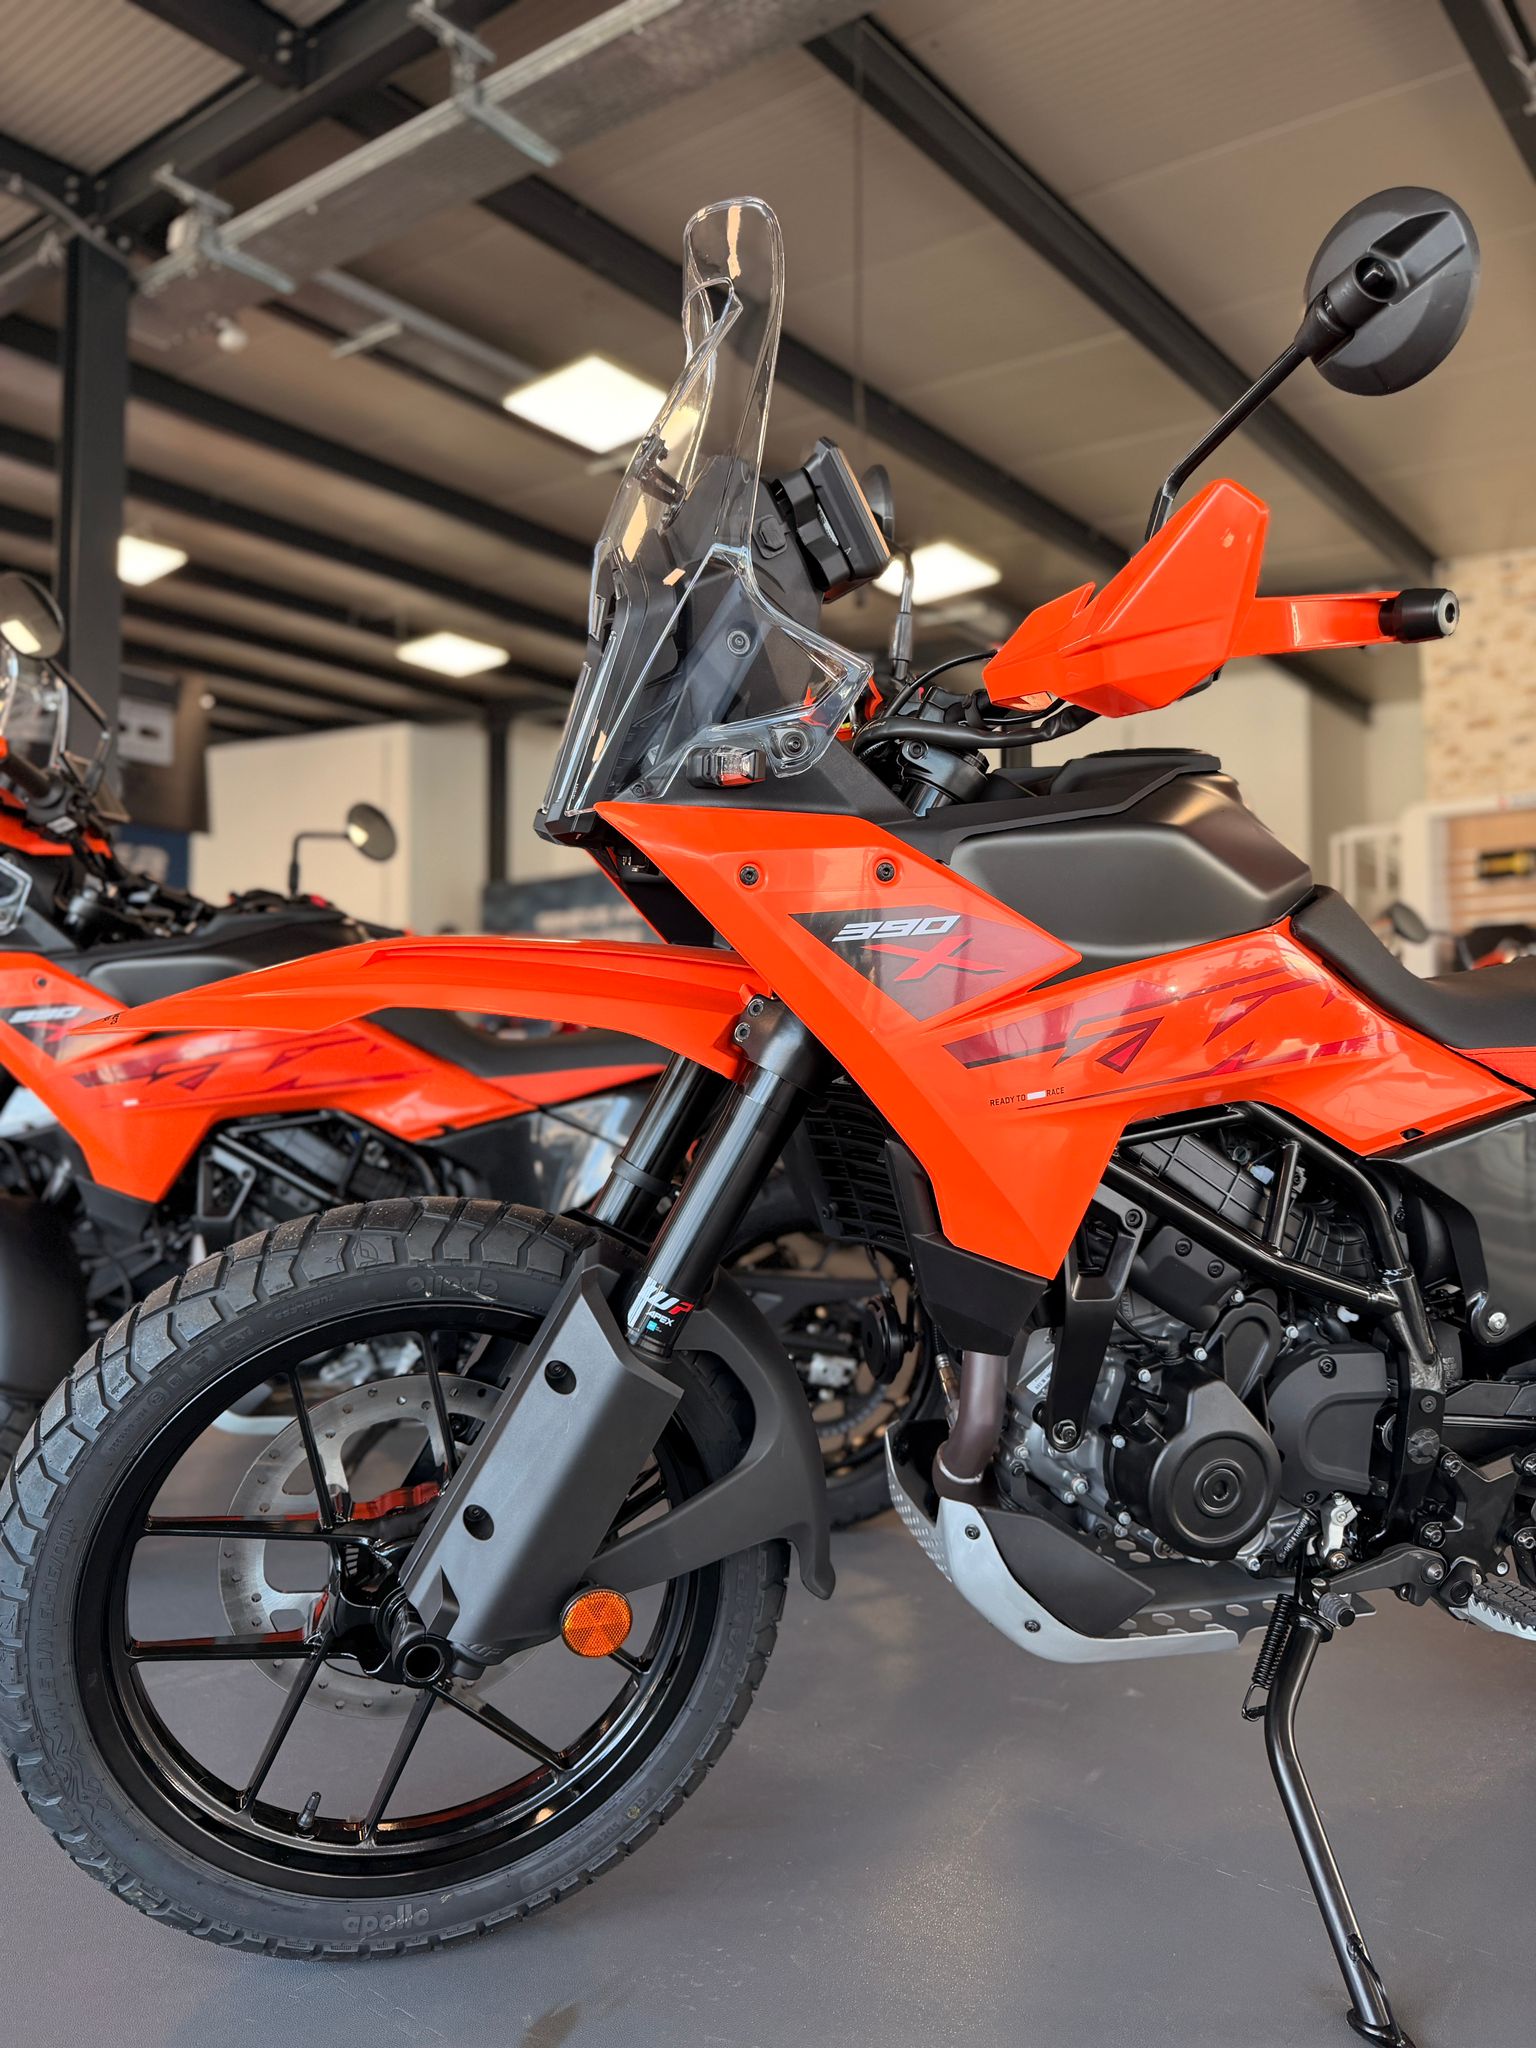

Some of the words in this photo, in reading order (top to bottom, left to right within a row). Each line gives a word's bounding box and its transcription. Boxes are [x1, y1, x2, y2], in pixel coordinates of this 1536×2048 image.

[831, 914, 961, 943] 390
[859, 933, 1008, 983] X
[989, 1095, 1015, 1107] READY
[1016, 1093, 1026, 1102] TO
[1046, 1086, 1065, 1097] RACE
[645, 1310, 675, 1328] APEX
[342, 1903, 431, 1938] apollo
